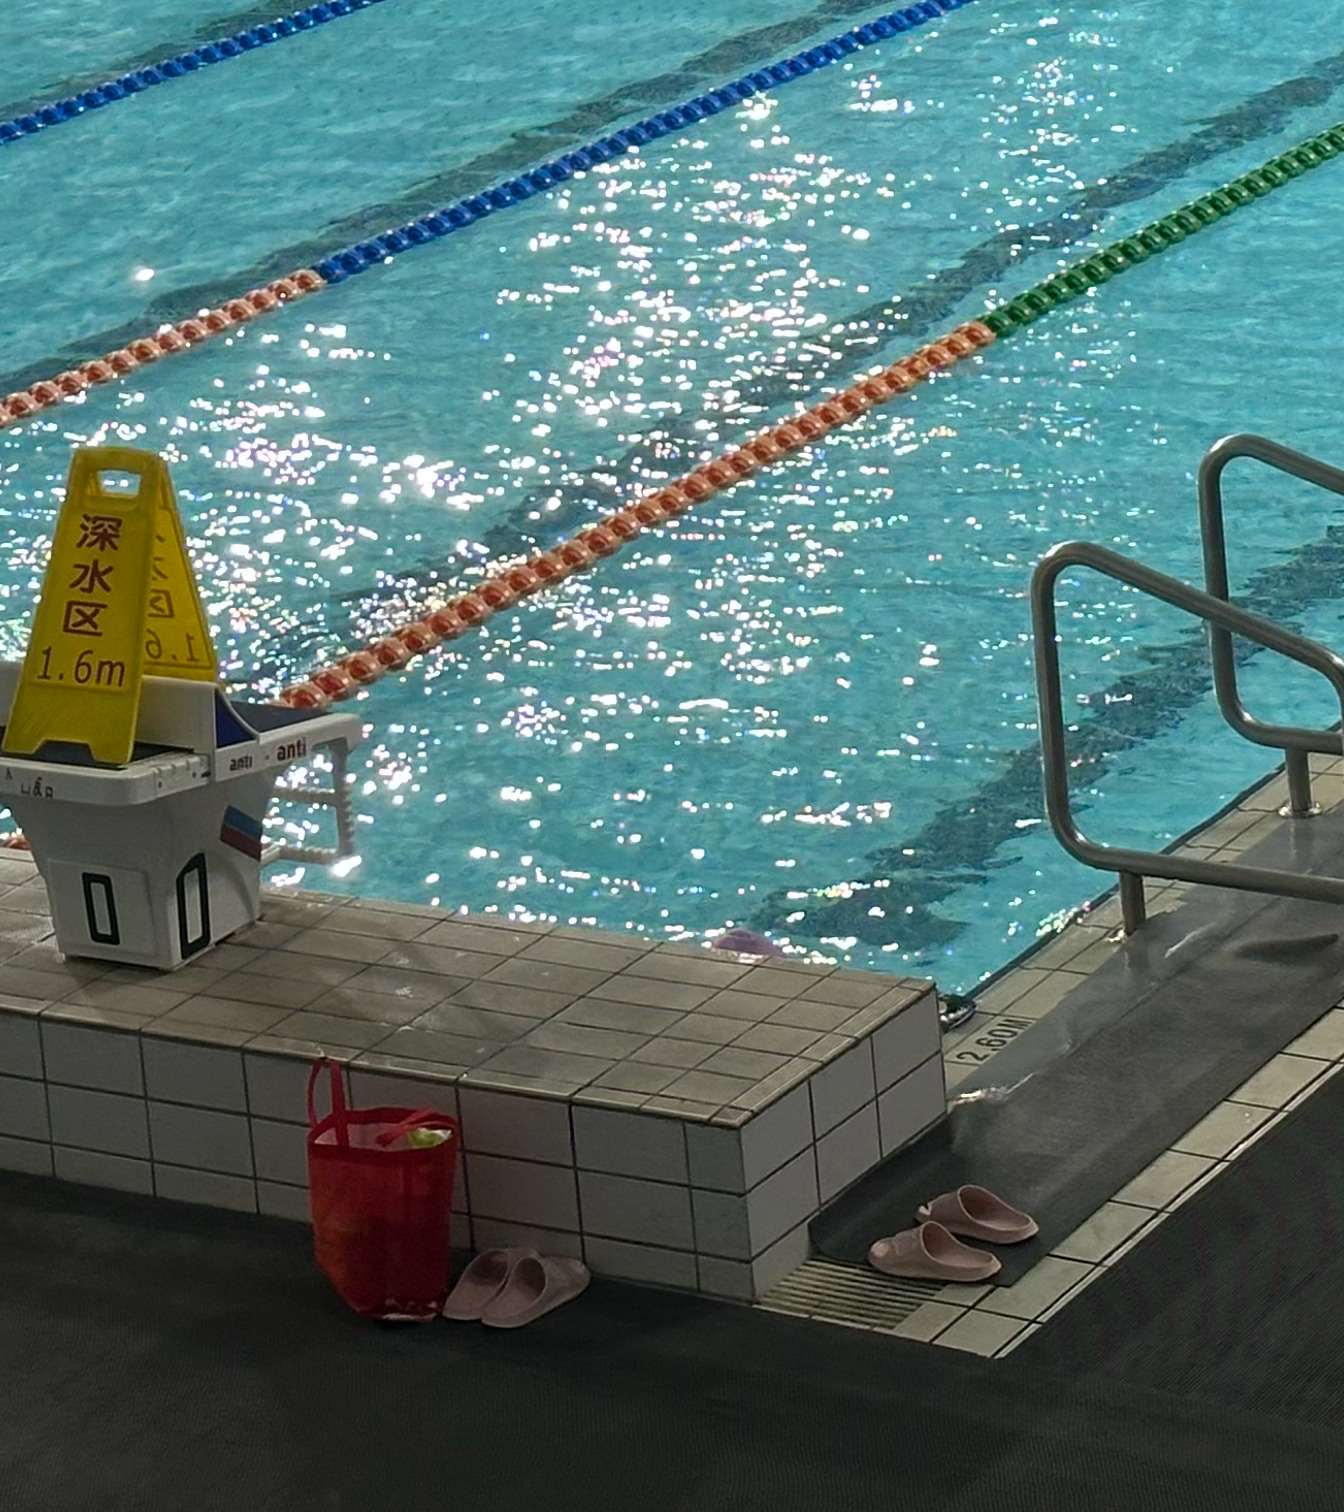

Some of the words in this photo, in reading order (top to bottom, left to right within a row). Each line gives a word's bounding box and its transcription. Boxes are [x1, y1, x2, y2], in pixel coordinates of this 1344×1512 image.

[62, 513, 123, 637] 深水区
[36, 646, 126, 688] 1.6m
[276, 737, 308, 761] anti
[956, 1018, 1033, 1062] 2.60M
